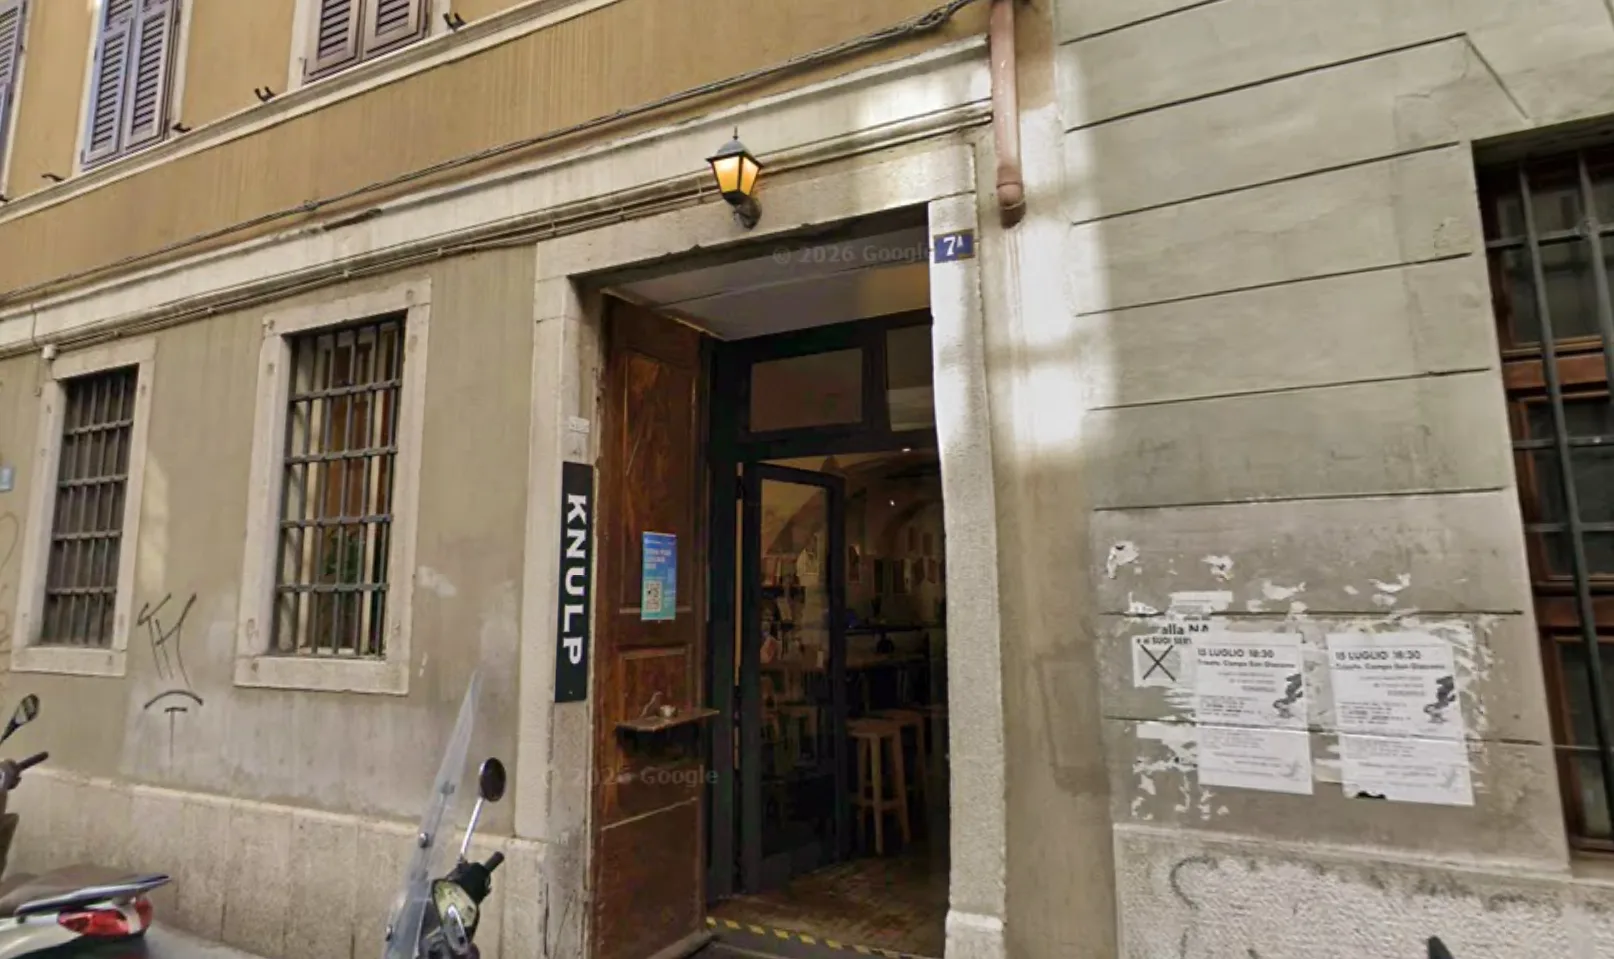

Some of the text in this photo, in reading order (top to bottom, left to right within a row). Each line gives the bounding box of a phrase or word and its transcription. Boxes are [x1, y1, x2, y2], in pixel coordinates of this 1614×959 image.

[563, 493, 587, 666] KNULP
[1209, 648, 1245, 658] LUGLIO
[1348, 651, 1388, 660] LUGLIO
